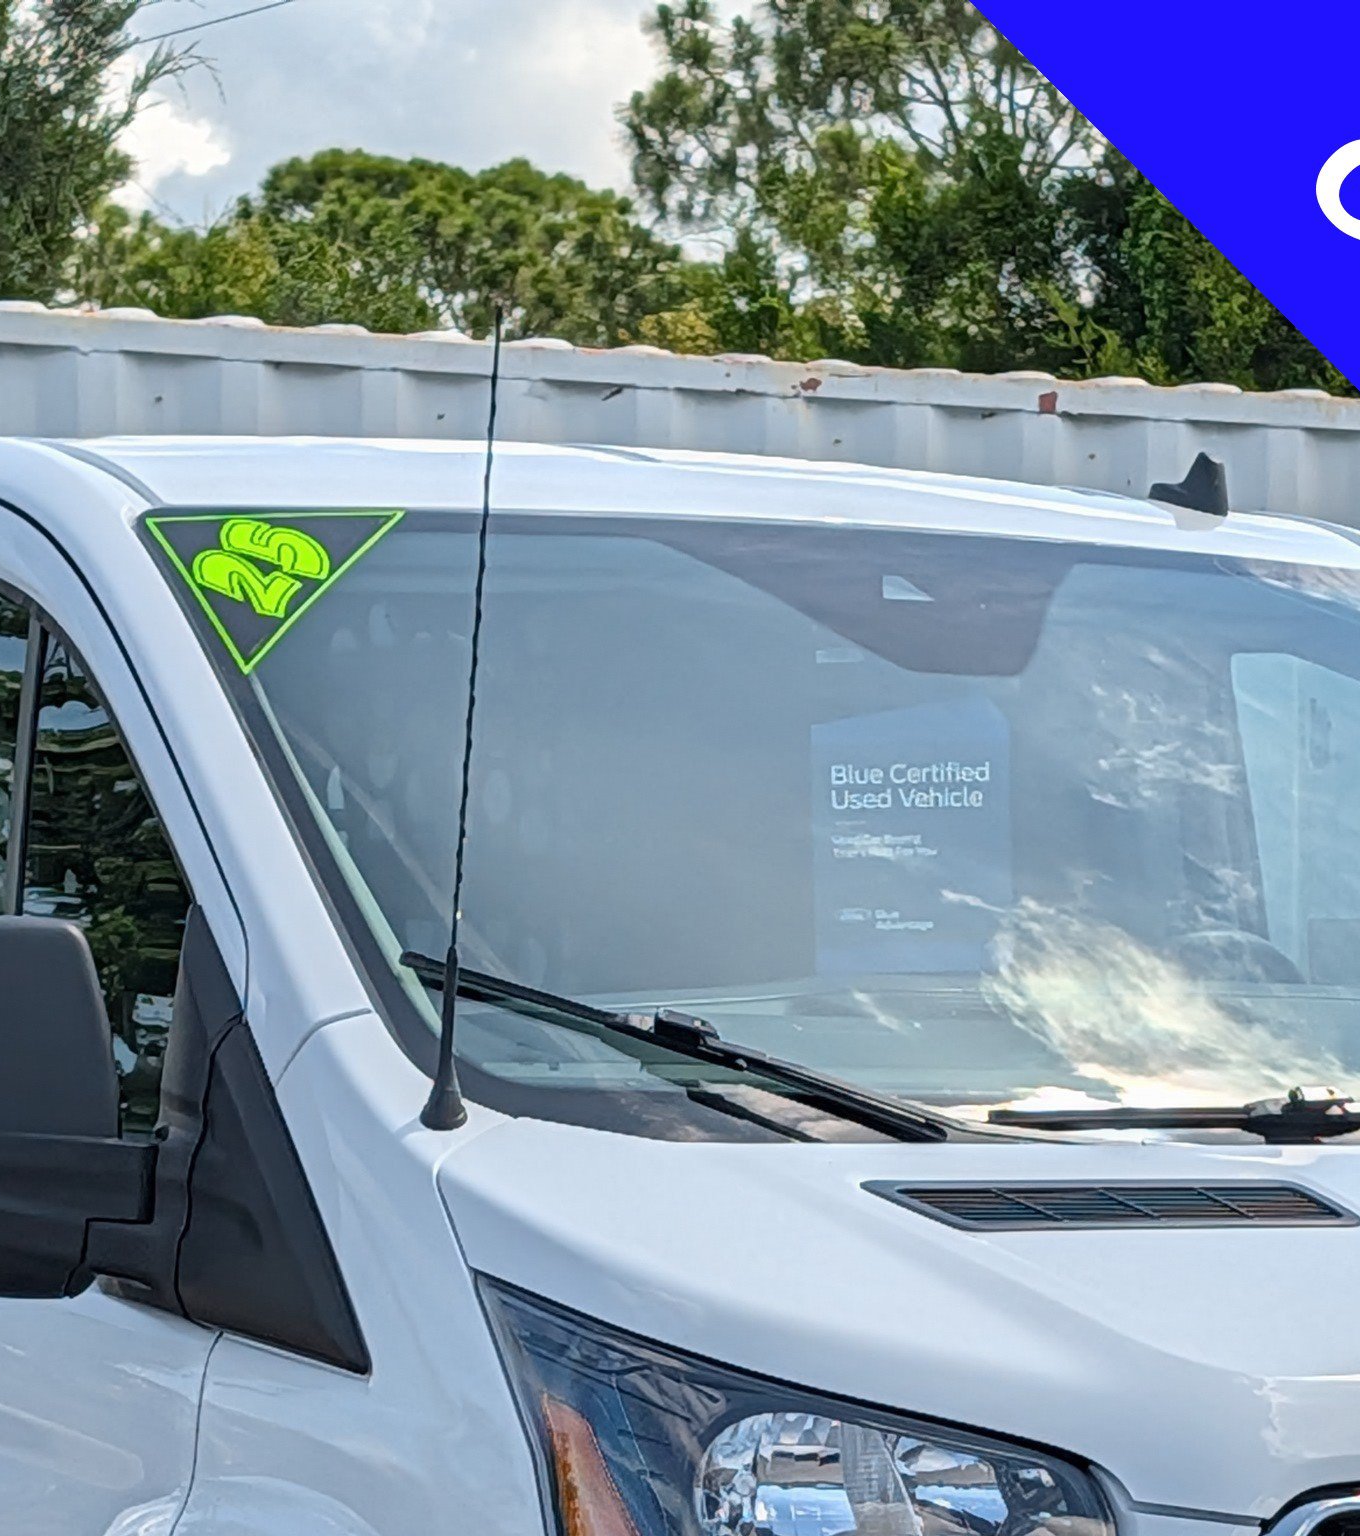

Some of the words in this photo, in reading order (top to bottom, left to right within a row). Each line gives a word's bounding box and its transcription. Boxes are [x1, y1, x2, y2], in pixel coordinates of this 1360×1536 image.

[192, 518, 331, 619] 25
[830, 763, 885, 786] Blue
[889, 760, 991, 784] Certified
[830, 787, 892, 810] Used
[897, 785, 984, 808] Vehicle
